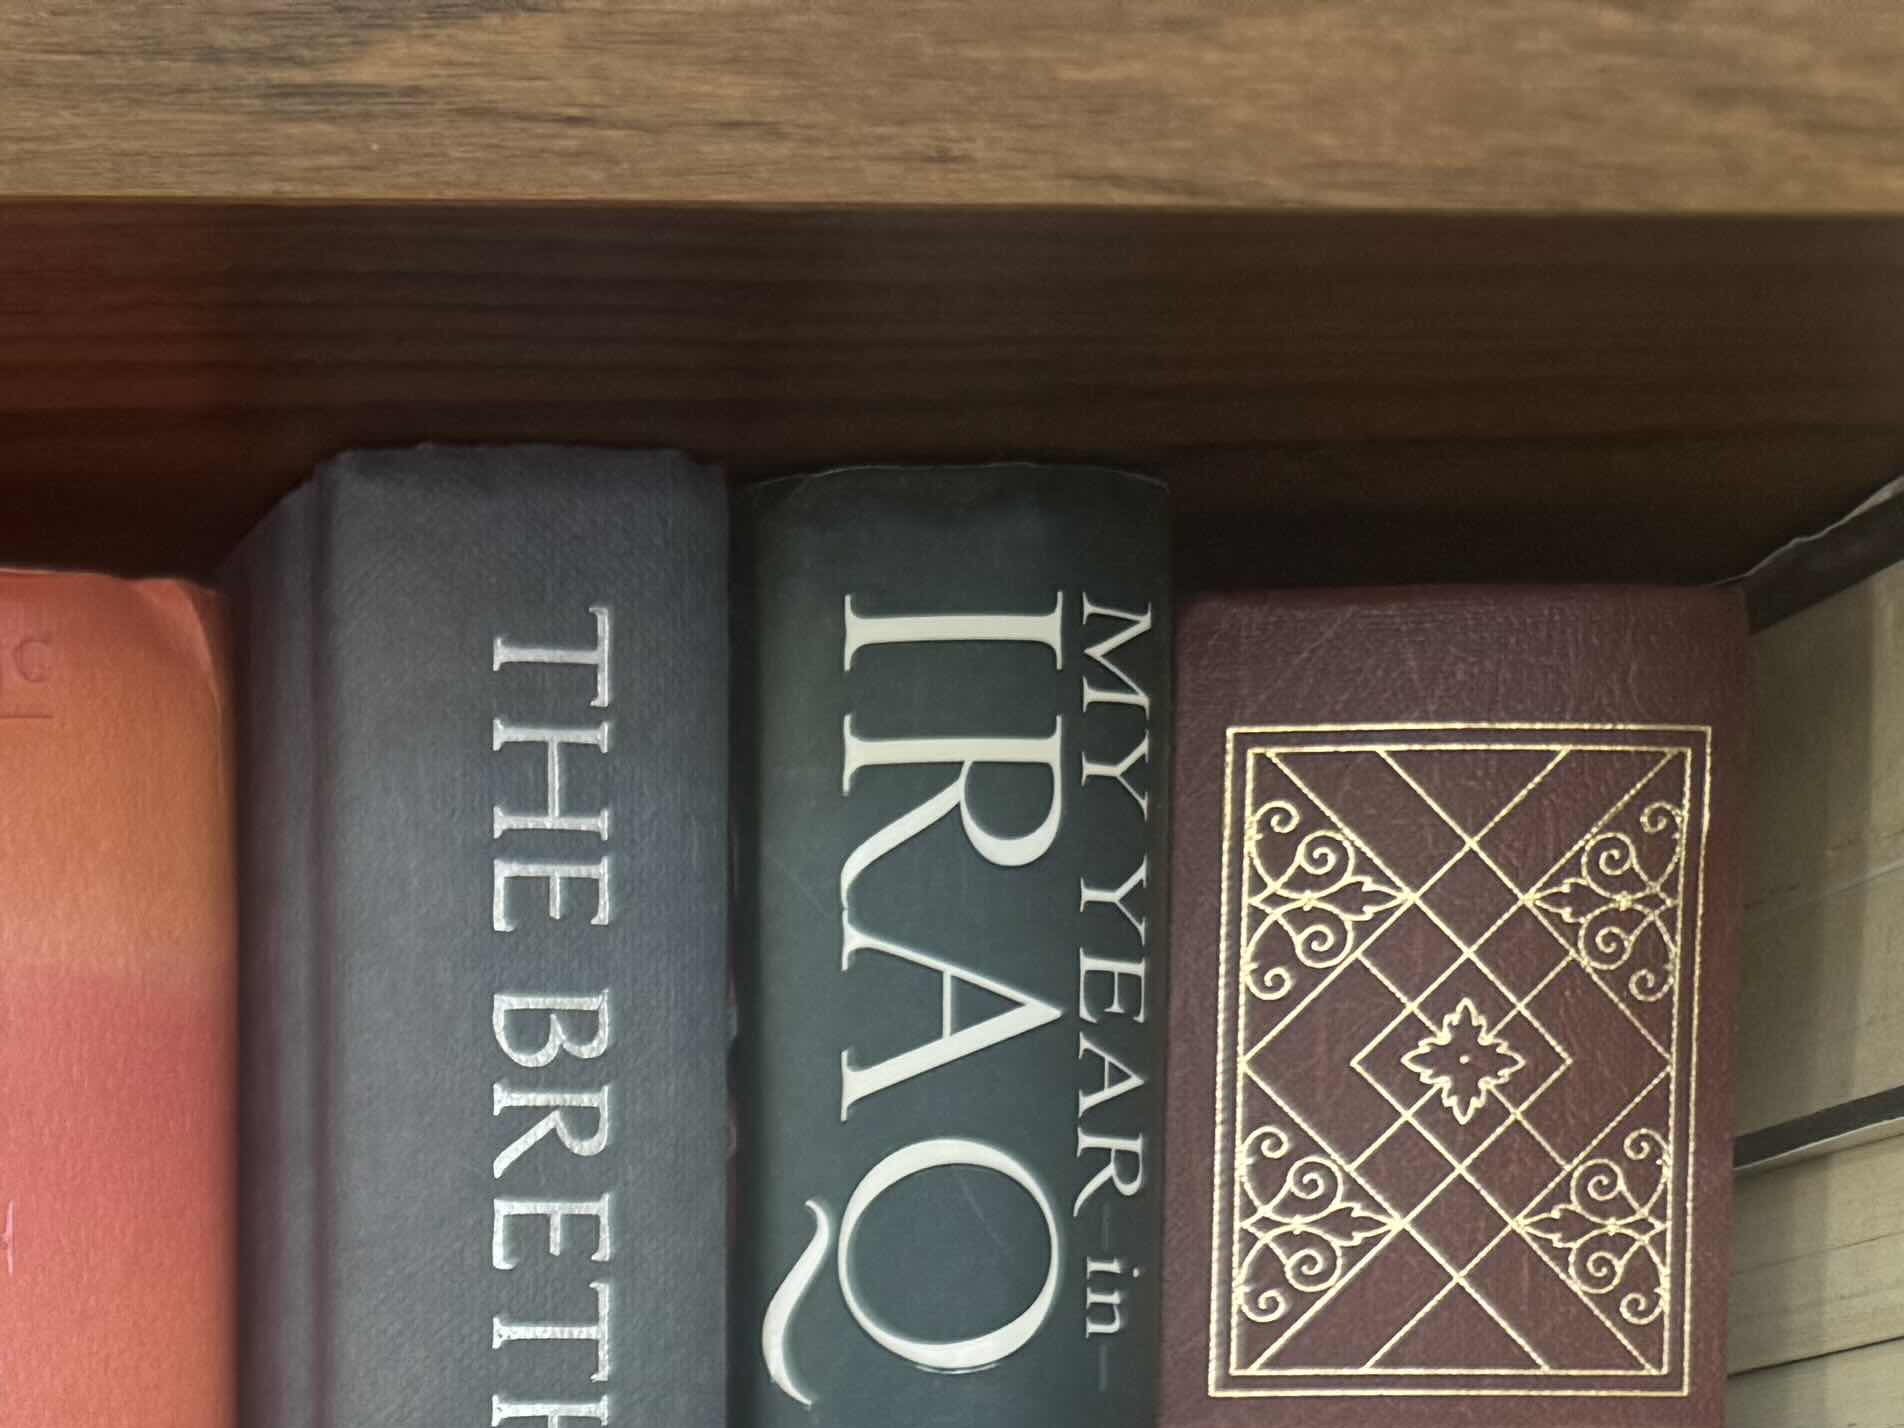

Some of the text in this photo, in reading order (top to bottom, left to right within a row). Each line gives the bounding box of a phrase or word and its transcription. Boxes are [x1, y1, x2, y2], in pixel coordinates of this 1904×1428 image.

[490, 605, 612, 932] THE
[760, 590, 1064, 1412] IRAQ
[1072, 590, 1152, 1340] MY YEAR in
